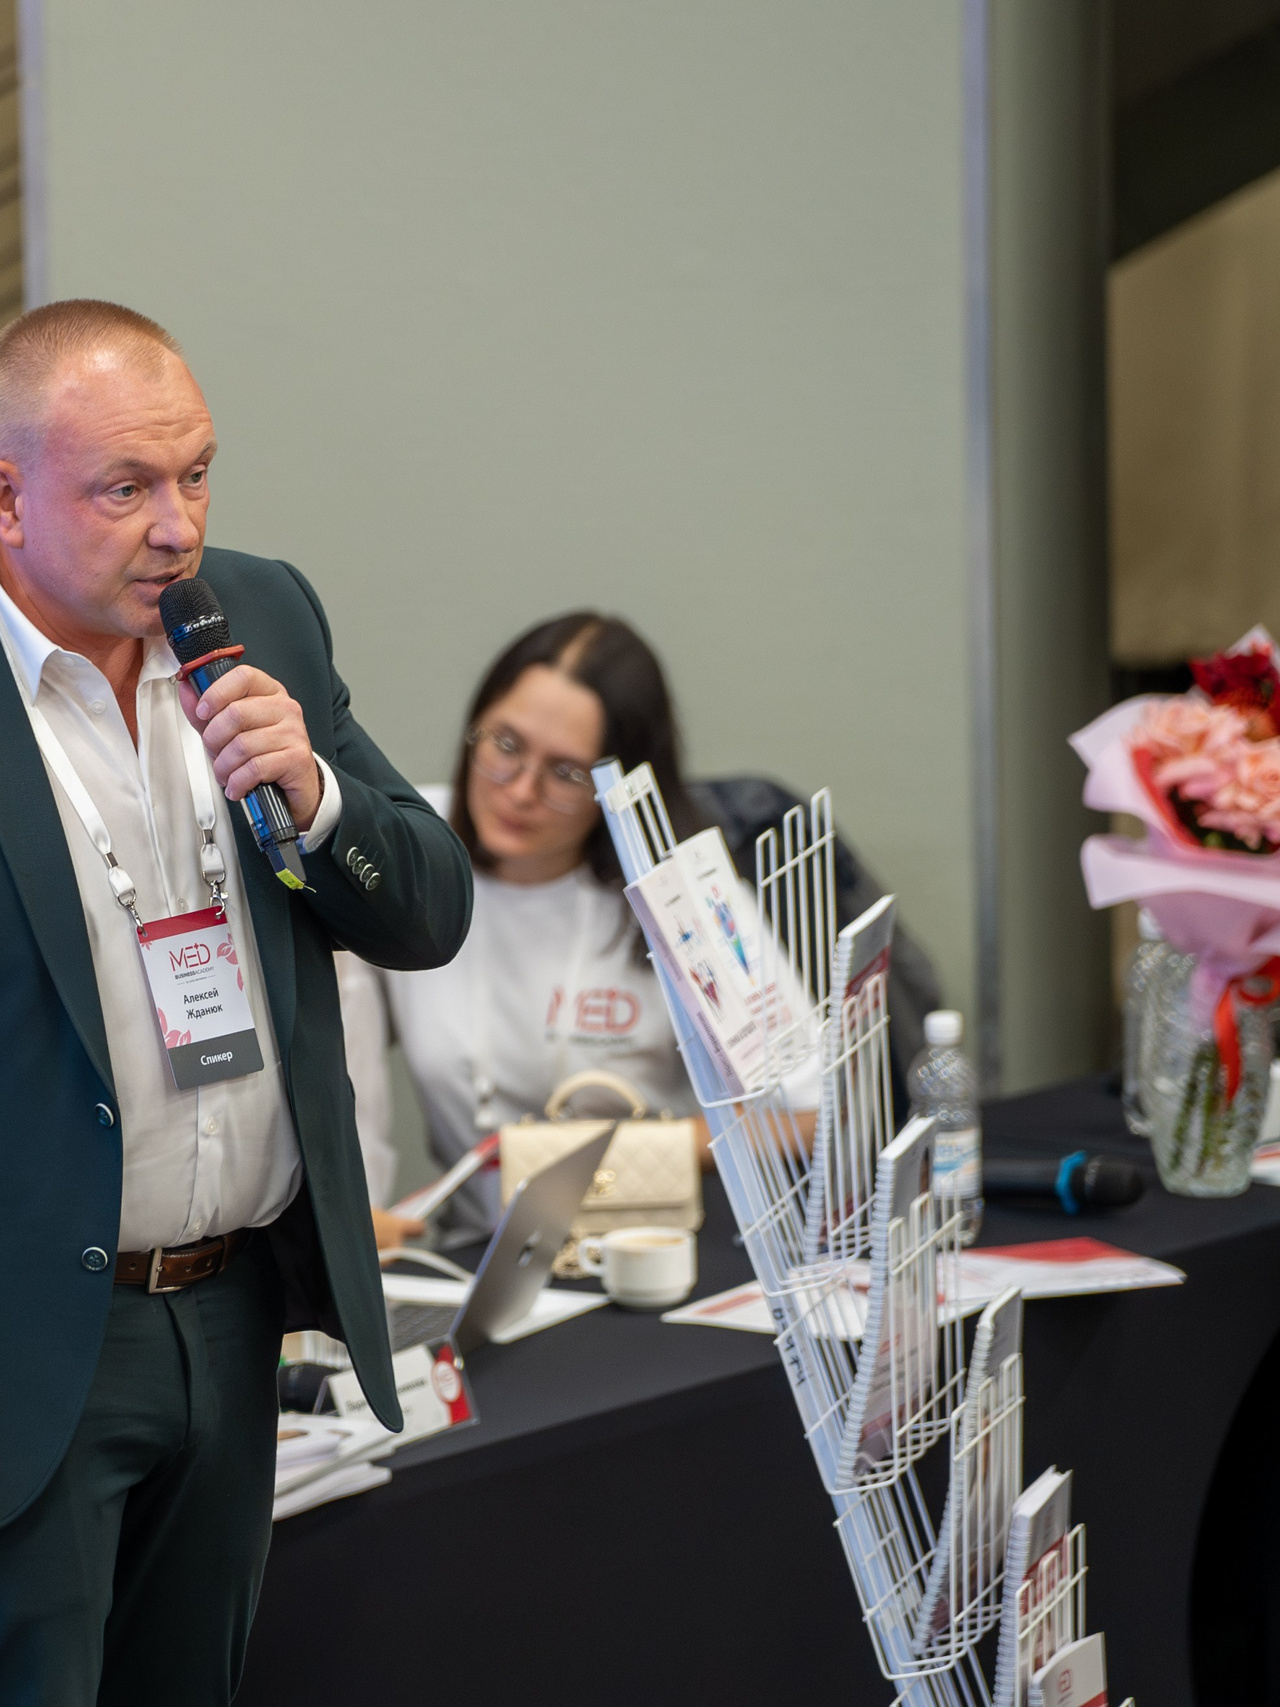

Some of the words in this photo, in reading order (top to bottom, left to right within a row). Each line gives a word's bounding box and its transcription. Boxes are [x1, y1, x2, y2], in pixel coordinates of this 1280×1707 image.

[168, 942, 211, 972] MED
[183, 987, 220, 1005] Алексей
[186, 1004, 224, 1020] Жданюк
[200, 1051, 234, 1066] Спикер
